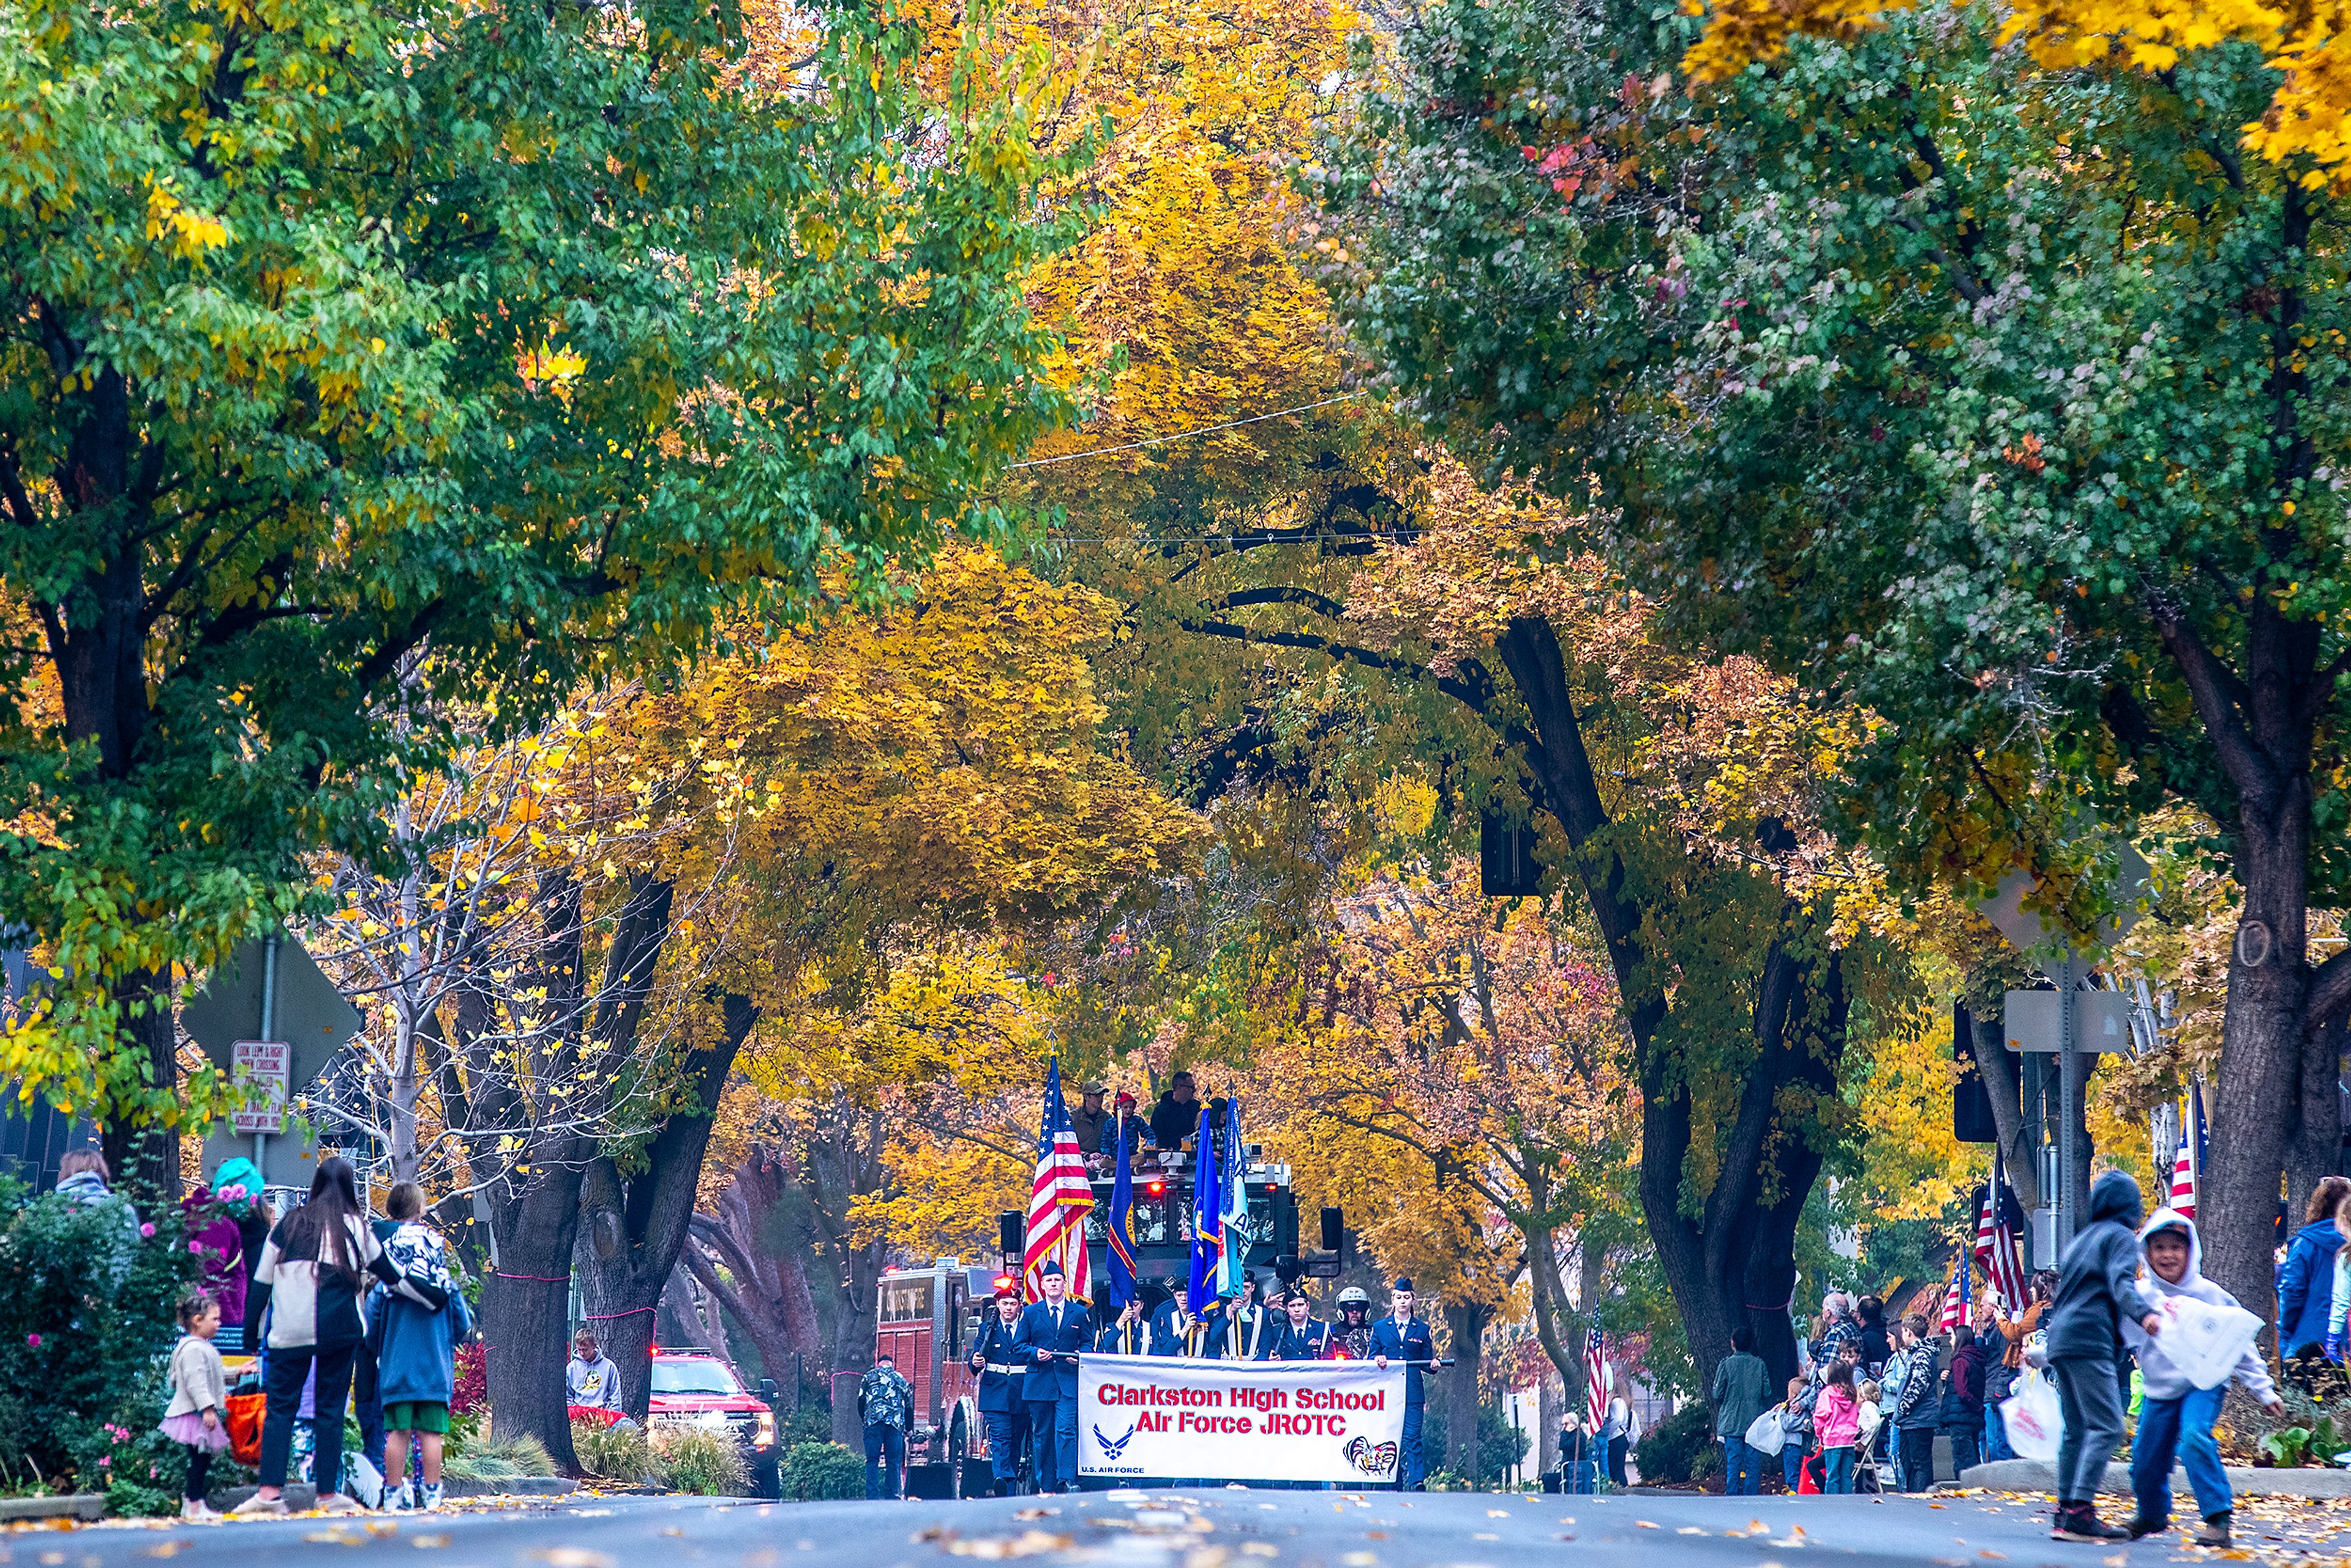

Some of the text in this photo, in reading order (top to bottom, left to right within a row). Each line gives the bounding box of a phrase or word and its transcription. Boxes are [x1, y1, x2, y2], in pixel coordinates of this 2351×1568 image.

[237, 1046, 249, 1056] LOOK
[265, 1047, 269, 1058] &
[257, 1059, 279, 1070] CROSSING
[1104, 1278, 1151, 1286] PCE
[1098, 1382, 1385, 1412] Clarkston High School
[1135, 1410, 1347, 1436] Air Force JROTC
